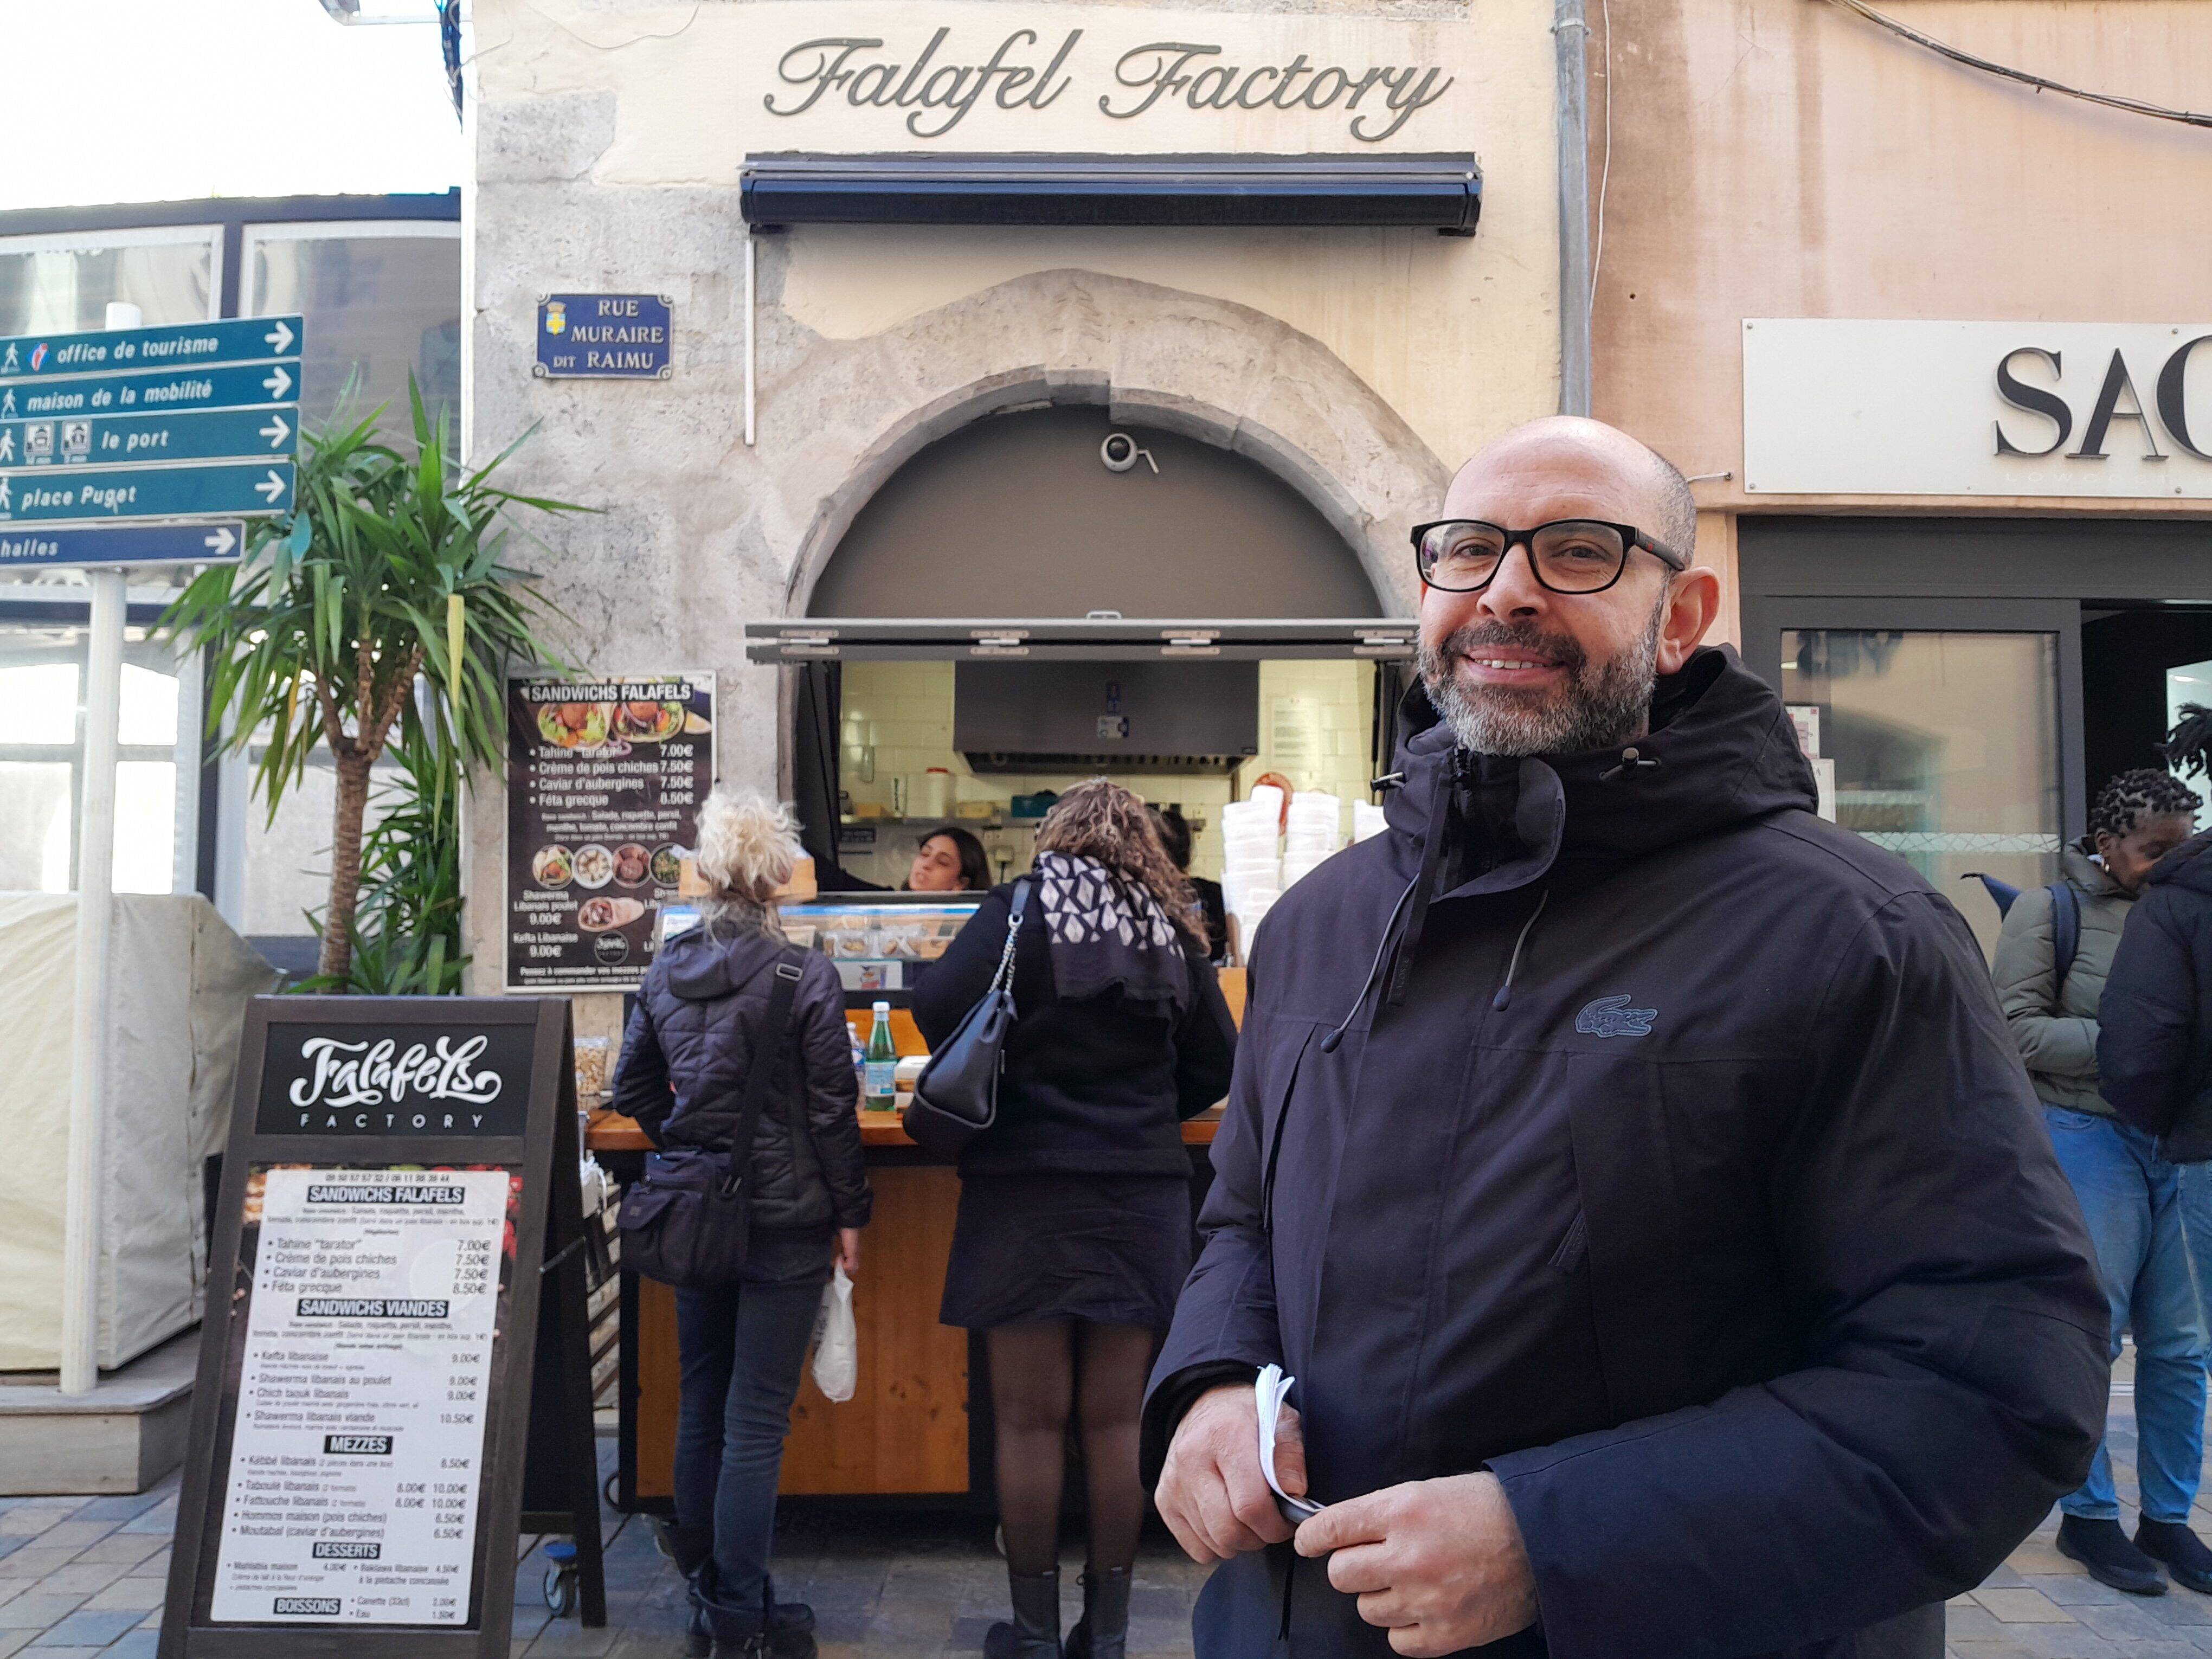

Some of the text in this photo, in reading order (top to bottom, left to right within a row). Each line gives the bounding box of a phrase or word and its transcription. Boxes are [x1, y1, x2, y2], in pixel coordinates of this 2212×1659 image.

[763, 27, 1456, 143] Falafel Factory
[597, 300, 639, 317] RUE
[571, 326, 664, 344] MURAIRE
[57, 336, 218, 364] office de tourisme
[553, 351, 653, 369] DIT RAIMU
[27, 379, 213, 412] maison de la mobilité
[101, 429, 169, 453] le port
[22, 485, 137, 515] place Puget
[531, 684, 691, 702] SANDWICHS FALAFELS
[660, 744, 693, 757] 7.00€
[576, 762, 590, 774] de
[593, 762, 615, 775] pois
[618, 761, 659, 774] chiches
[660, 760, 693, 773] 7.50€
[539, 777, 573, 791] Caviar
[565, 794, 609, 808] grecque
[290, 1035, 502, 1107] Falafels
[299, 1113, 483, 1129] FACTORY
[310, 1186, 463, 1203] SANDWICHS FALAFELS
[456, 1239, 491, 1251] 7.00€
[313, 1253, 326, 1264] de
[329, 1253, 352, 1266] pois
[355, 1253, 397, 1265] chiches
[455, 1254, 491, 1266] 7.50€
[273, 1267, 307, 1278] Caviar
[454, 1269, 488, 1281] 7.50€
[300, 1300, 446, 1317] SANDWICHS VIANDES
[331, 1437, 387, 1452] MEZZES
[316, 1544, 378, 1558] DESSERTS
[276, 1598, 339, 1613] BOISSONS
